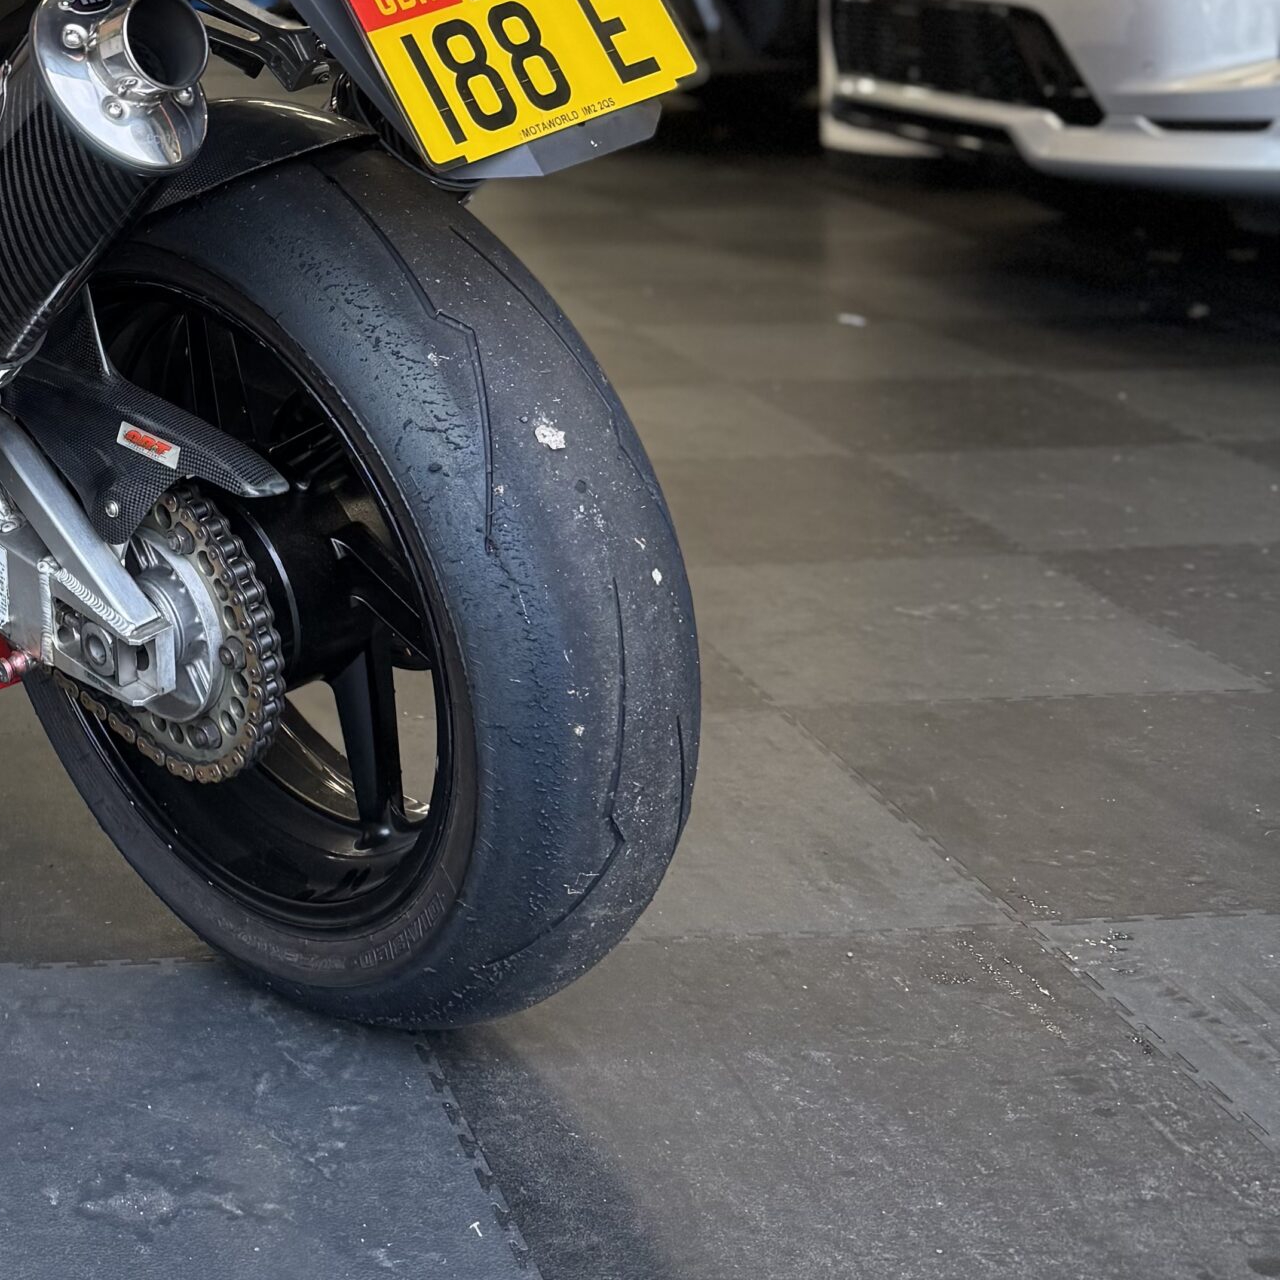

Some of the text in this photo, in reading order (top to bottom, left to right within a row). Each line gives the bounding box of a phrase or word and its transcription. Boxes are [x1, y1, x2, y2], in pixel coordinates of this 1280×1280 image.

[400, 1, 572, 145] 188
[521, 97, 616, 138] MOTAWORLD IM2 2QS
